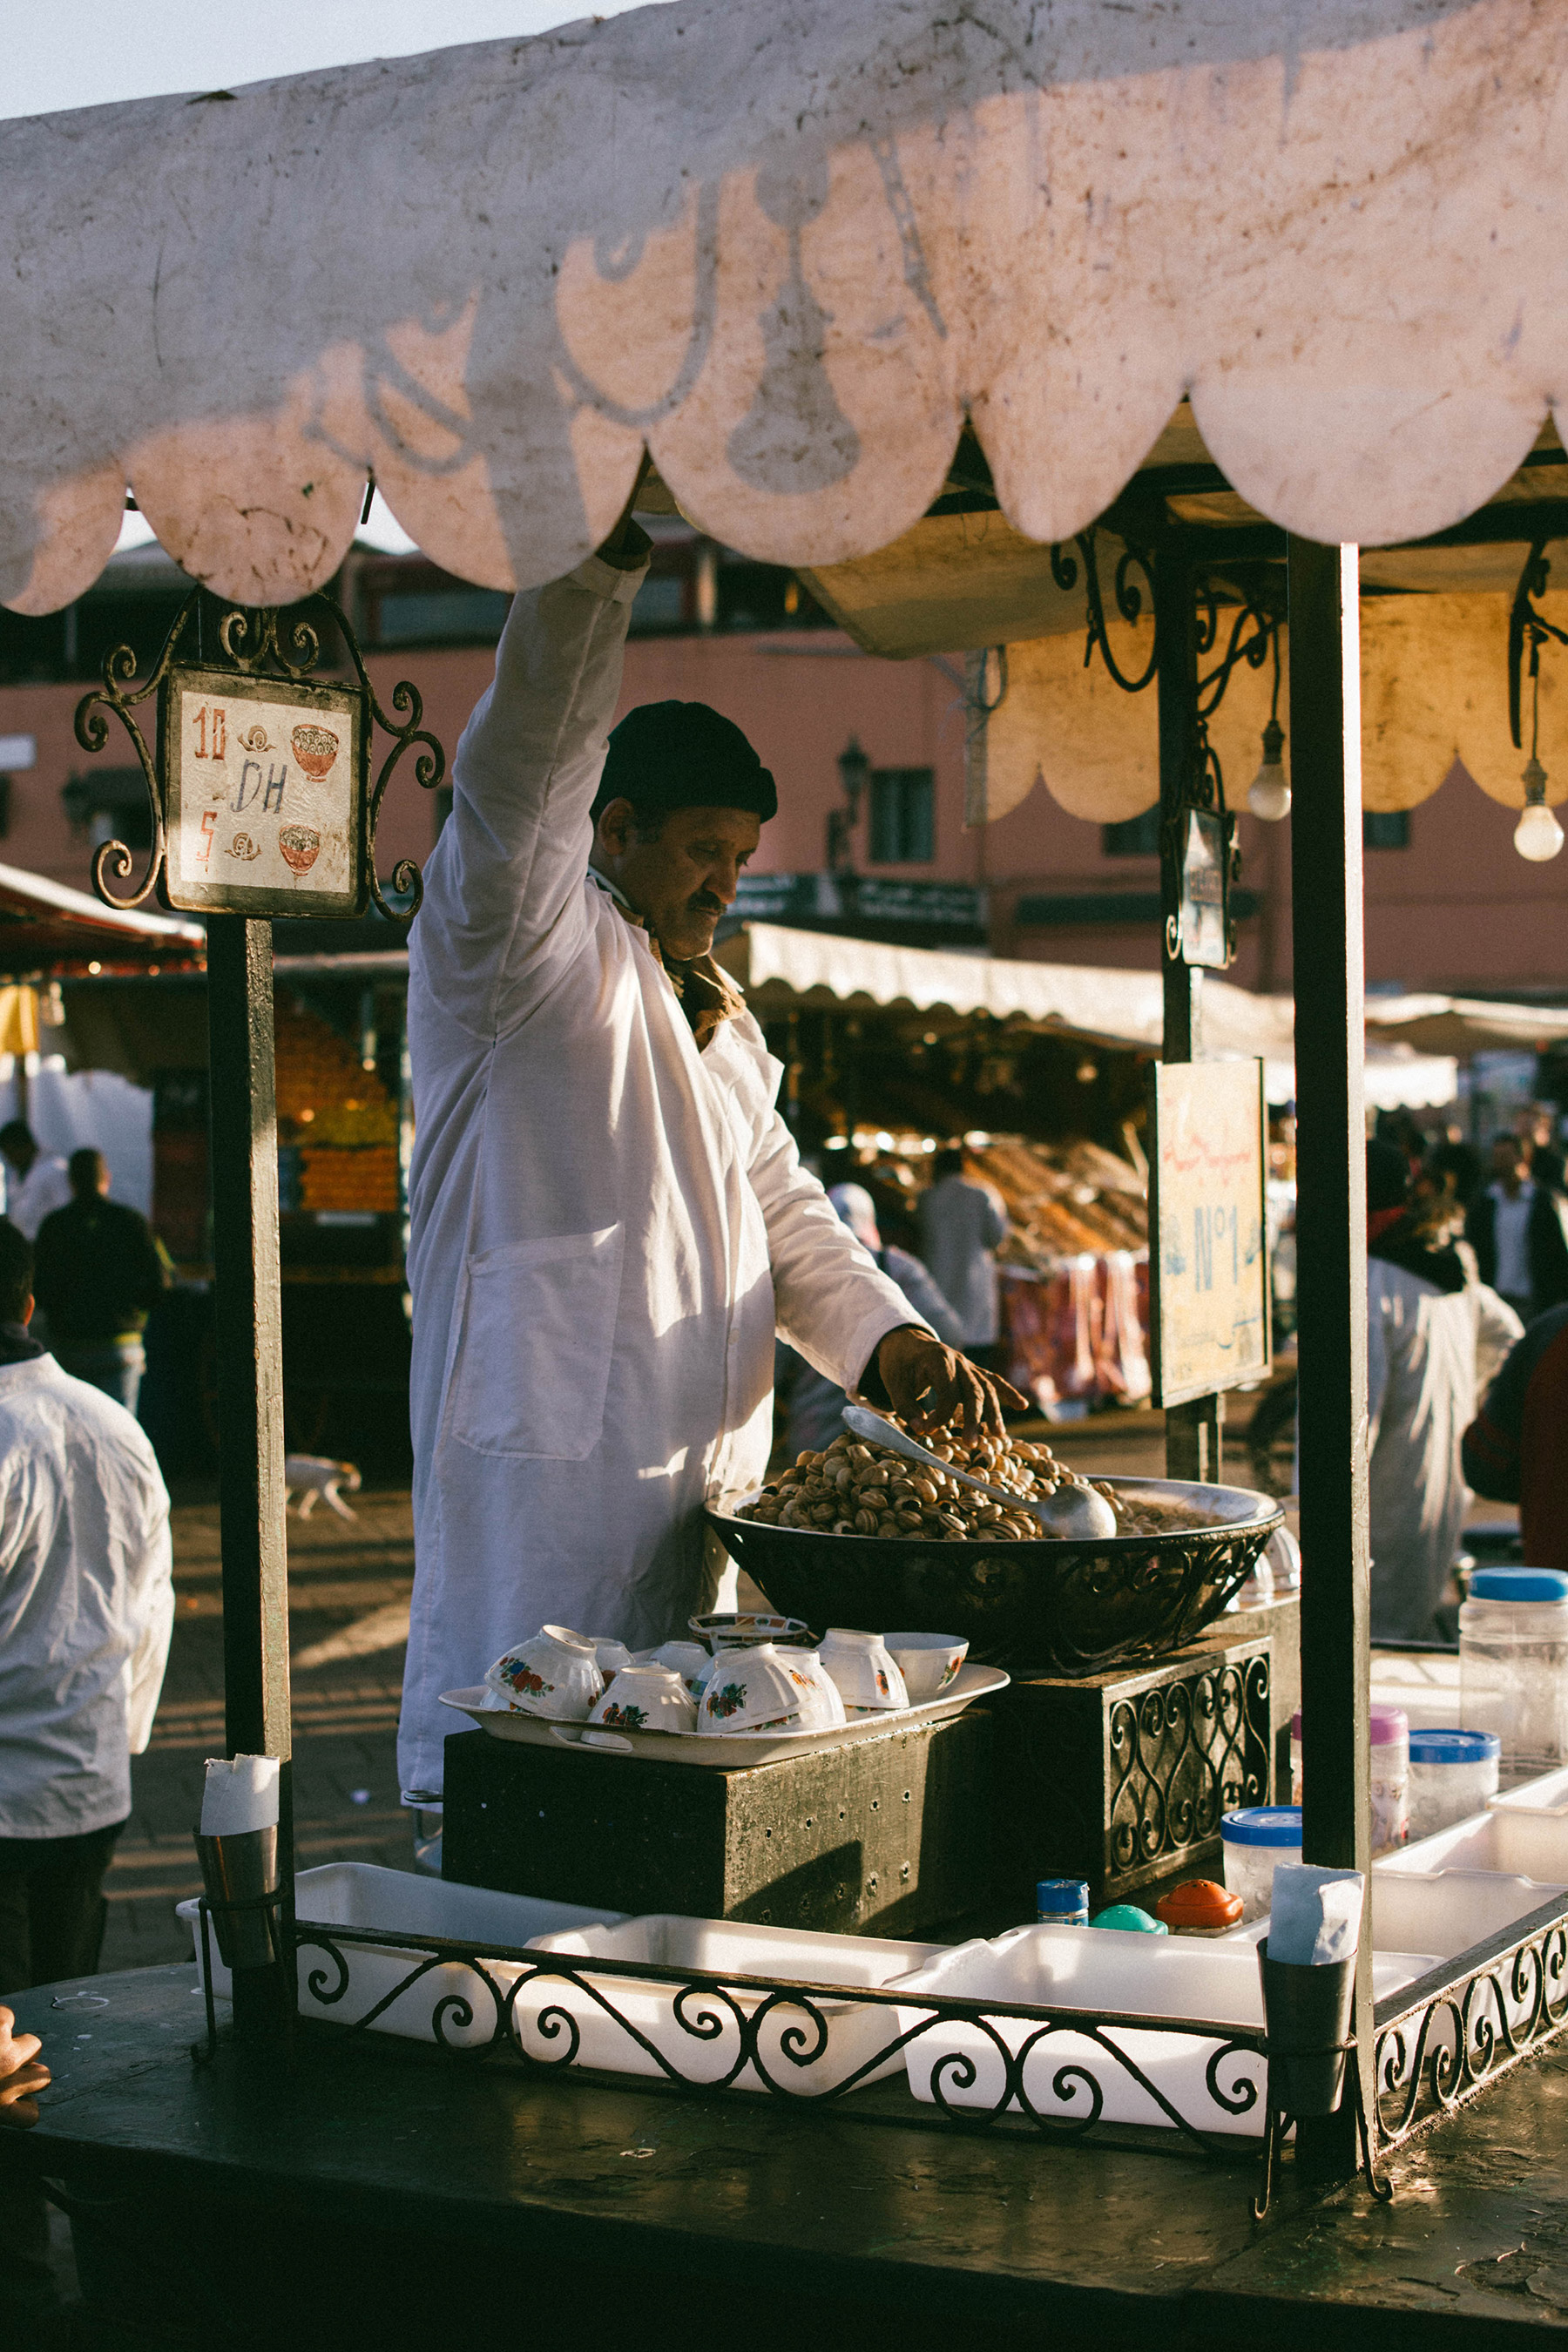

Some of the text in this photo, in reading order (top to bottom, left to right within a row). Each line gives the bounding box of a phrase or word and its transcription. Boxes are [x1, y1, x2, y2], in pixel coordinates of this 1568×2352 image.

[192, 706, 226, 760] 10
[230, 758, 288, 814] DH
[195, 810, 218, 862] 5
